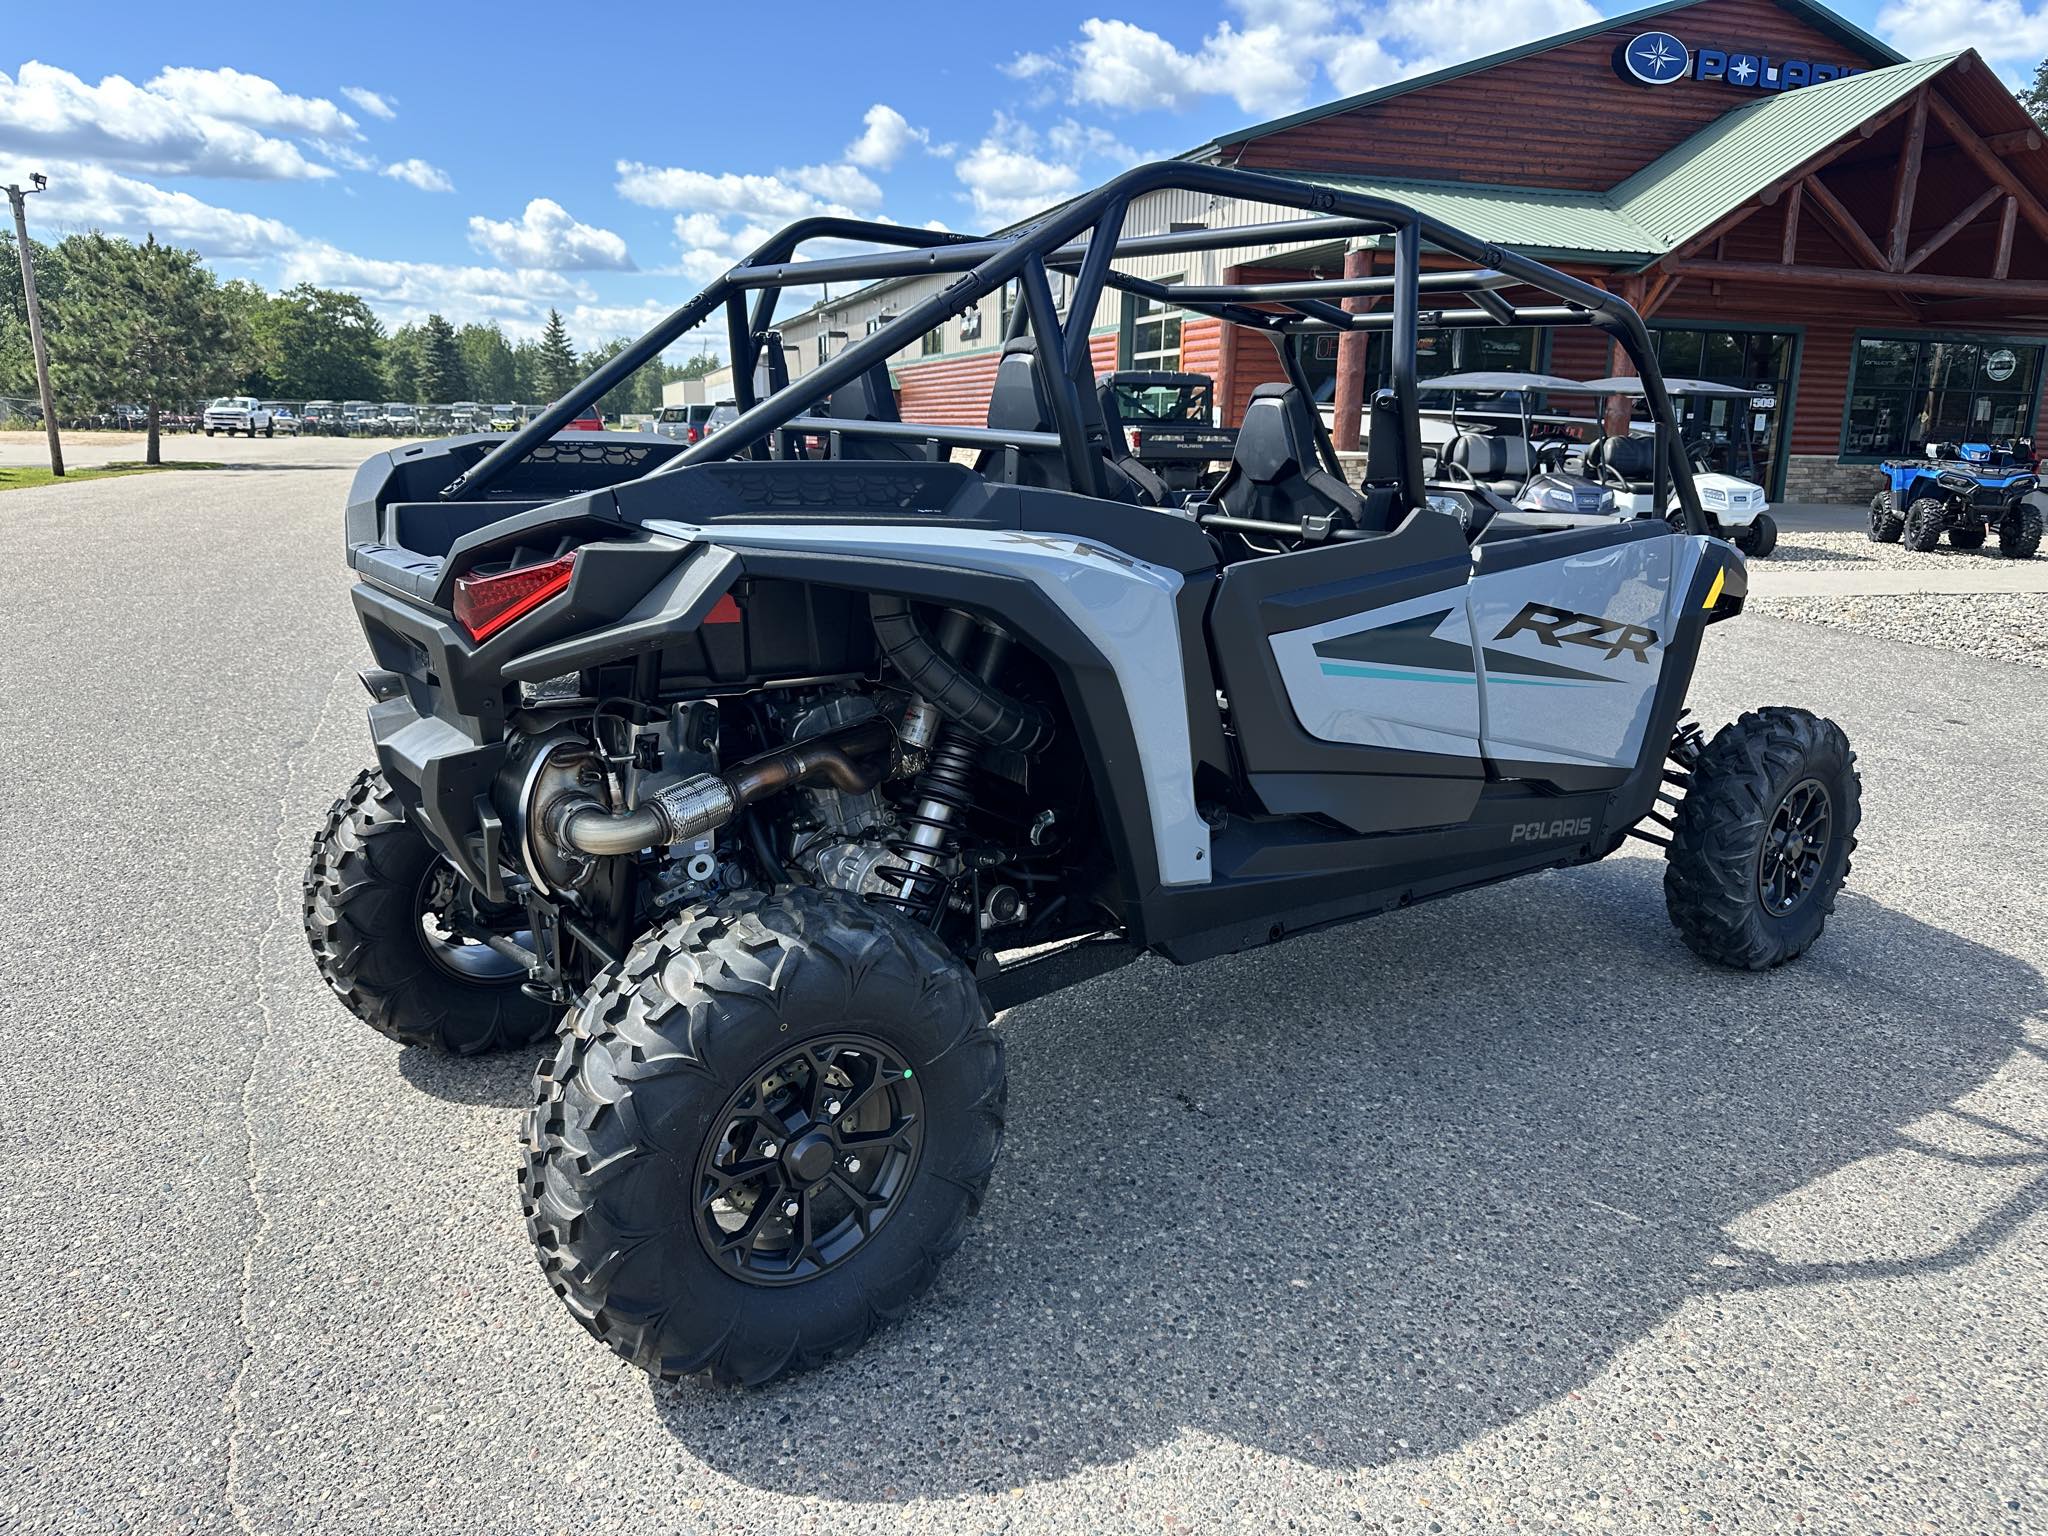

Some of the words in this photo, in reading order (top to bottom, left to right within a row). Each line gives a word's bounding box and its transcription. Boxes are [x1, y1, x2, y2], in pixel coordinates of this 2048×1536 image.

[1752, 398, 1775, 408] 509
[1492, 601, 1659, 664] RZR
[1510, 817, 1592, 843] POLARIS
